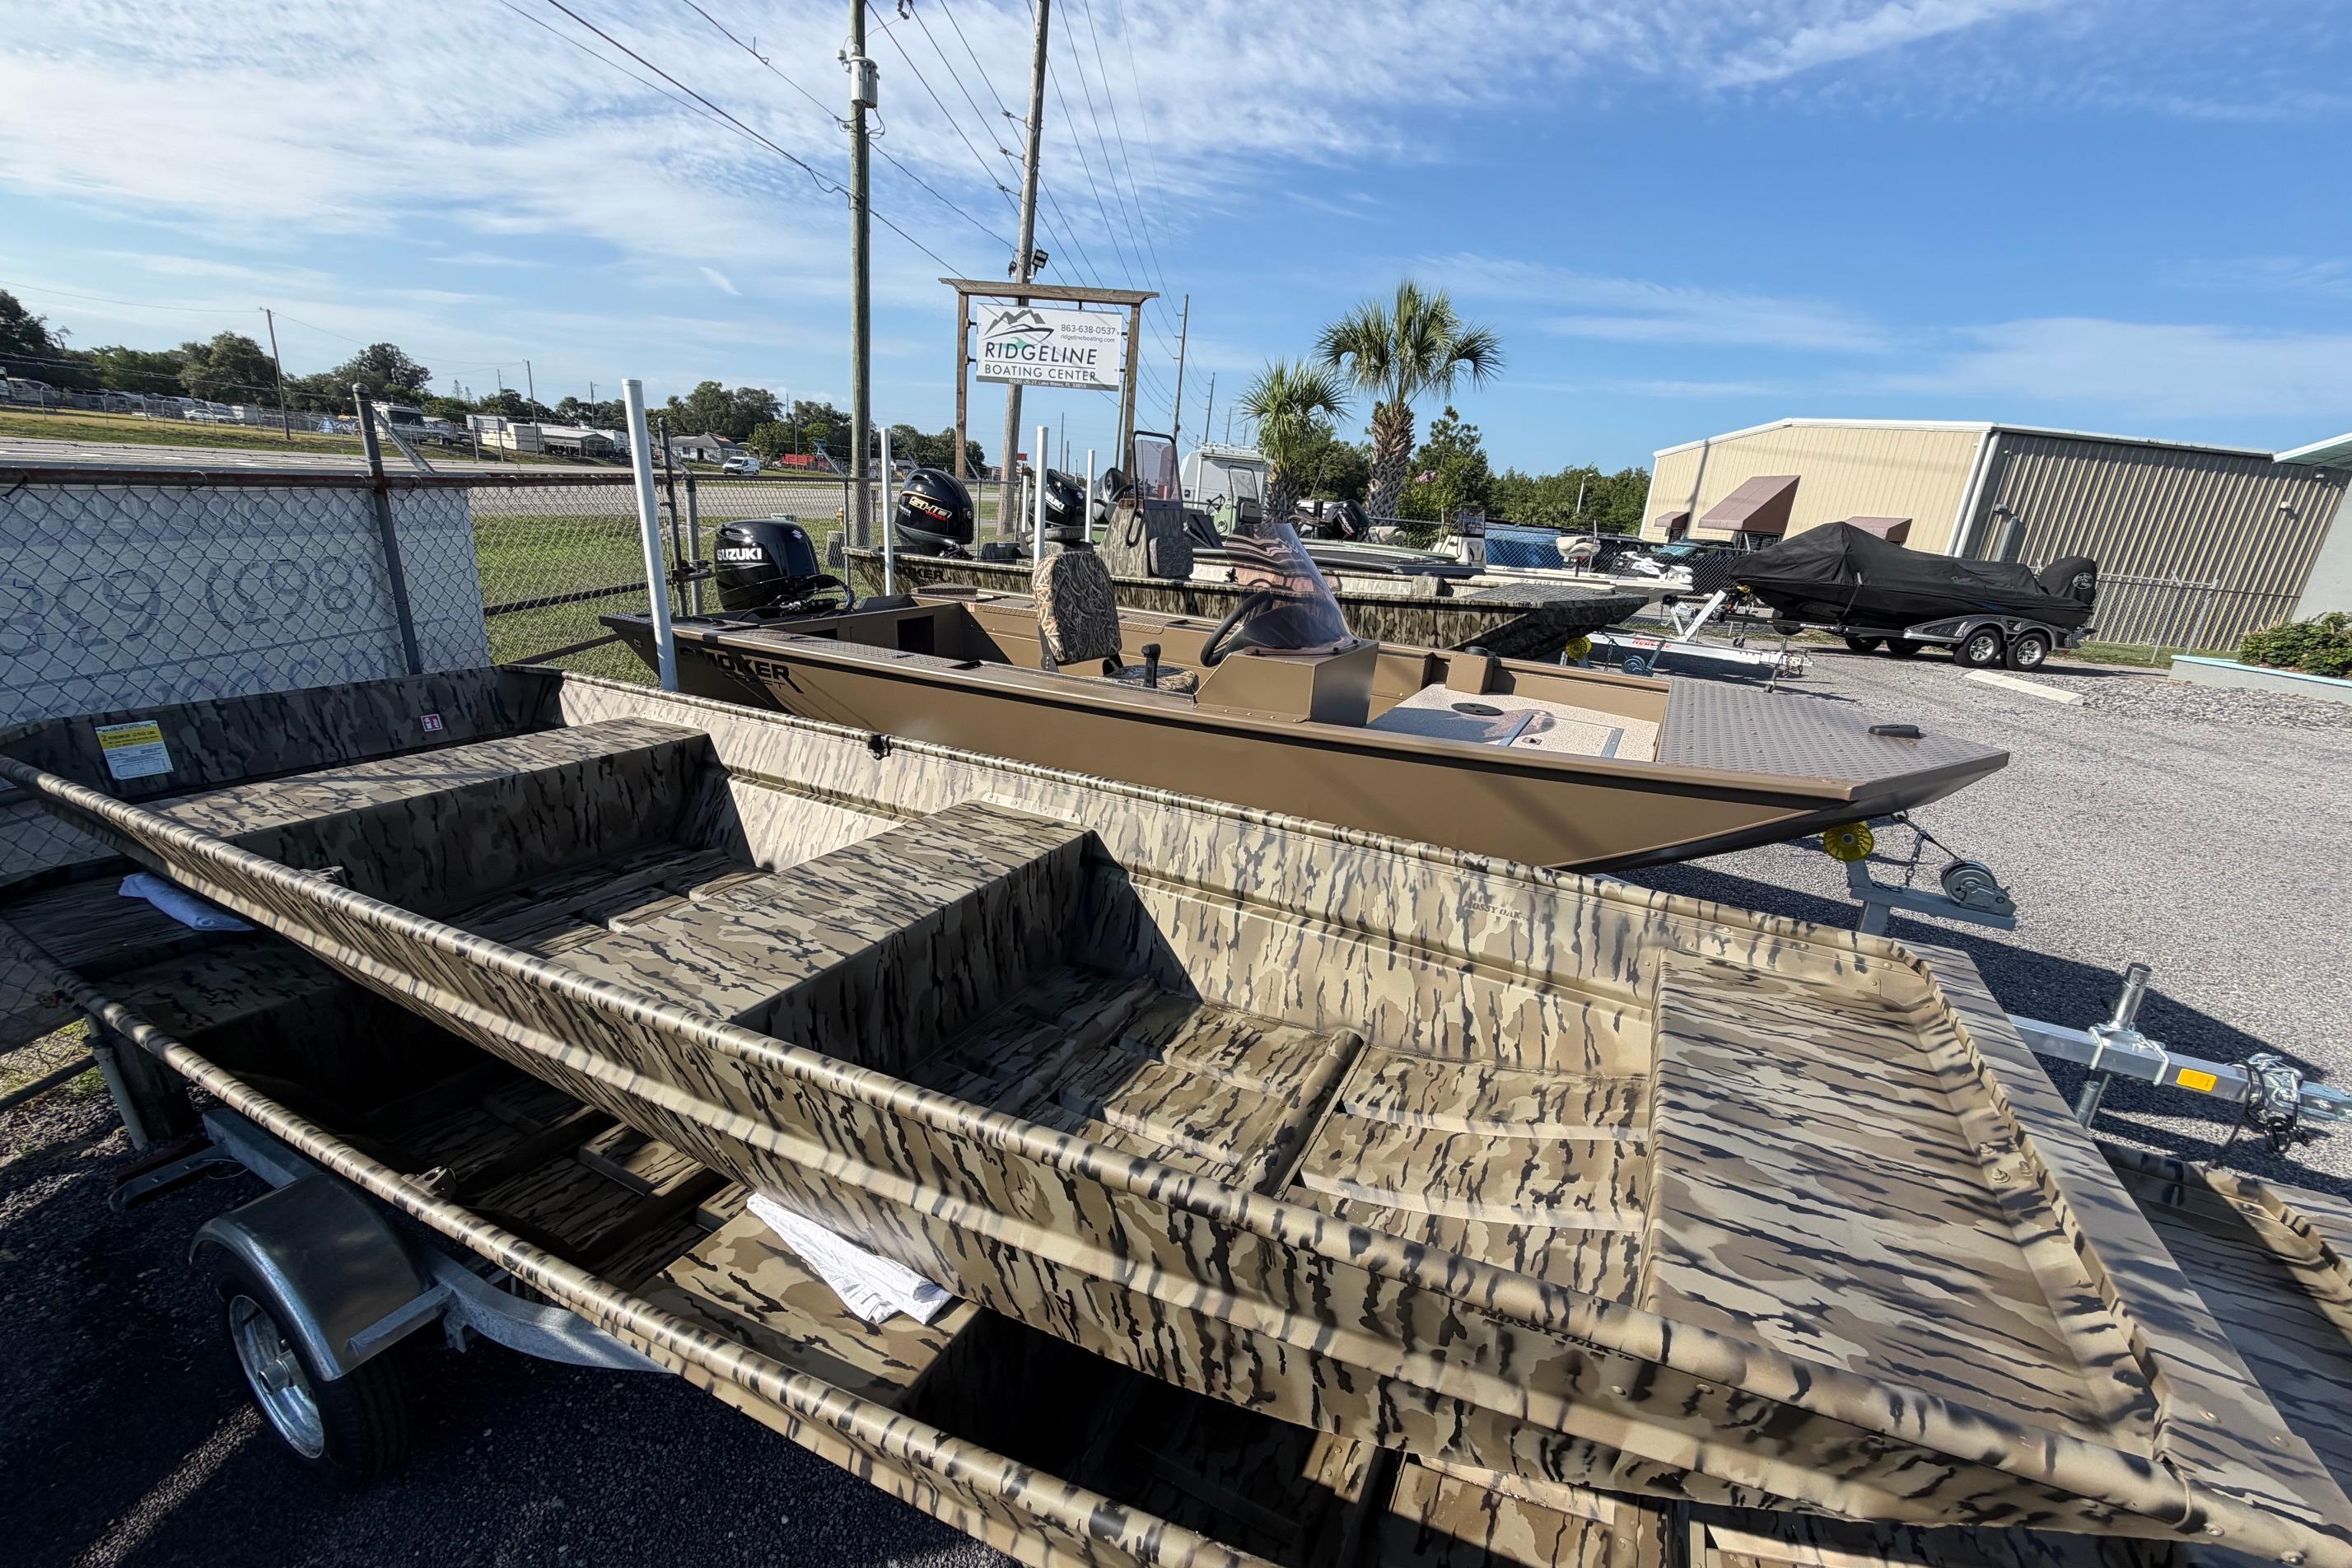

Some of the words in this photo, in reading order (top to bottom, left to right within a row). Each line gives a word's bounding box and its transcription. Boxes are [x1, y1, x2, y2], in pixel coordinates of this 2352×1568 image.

[1061, 324, 1116, 335] 863-638-0537
[985, 342, 1098, 365] RIDGELINE
[985, 364, 1043, 378] BOATING
[1048, 369, 1096, 381] CENTER
[716, 548, 763, 561] SUZUKI
[679, 646, 805, 694] SMOKER
[1463, 901, 1498, 913] MOSSY
[1499, 908, 1523, 920] OAK
